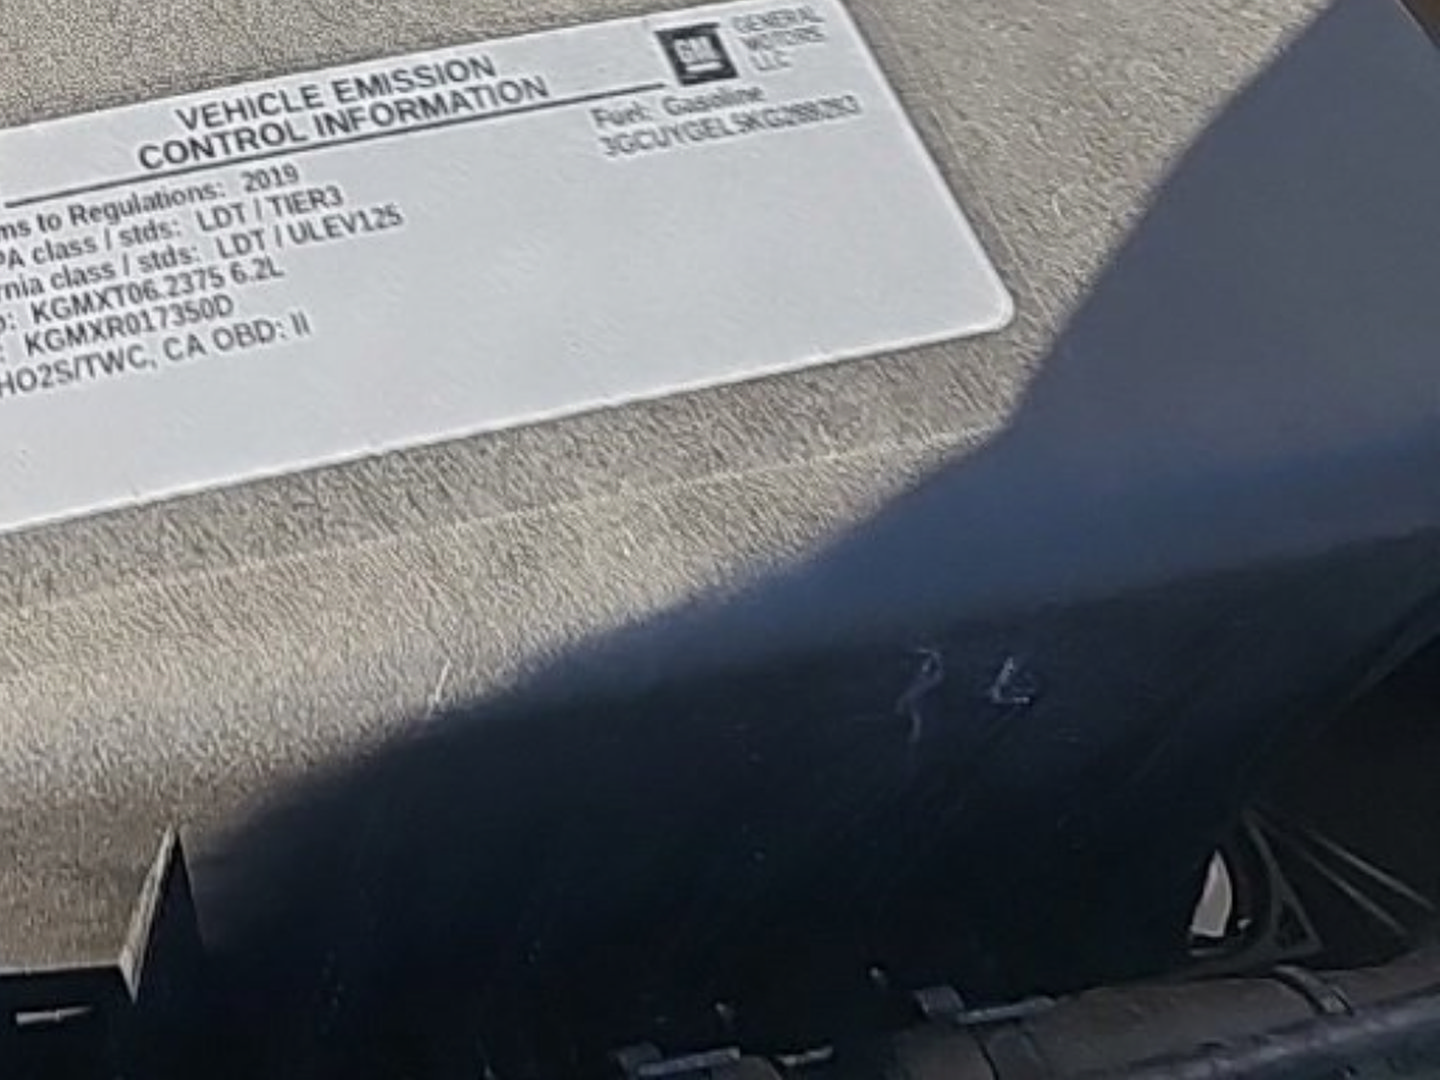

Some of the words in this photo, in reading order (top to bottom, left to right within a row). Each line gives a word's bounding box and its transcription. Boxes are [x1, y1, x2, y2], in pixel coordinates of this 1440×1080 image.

[138, 120, 307, 170] CONTROL
[313, 76, 550, 137] INFORMATION
[176, 83, 324, 131] VEHICLE
[331, 55, 497, 104] EMISSION
[662, 86, 764, 116] Gasoline
[32, 236, 98, 265] class
[118, 219, 182, 248] stds:
[196, 202, 246, 232] LDT
[265, 185, 344, 218] TIER3
[37, 212, 63, 232] to
[68, 182, 226, 226] Regulations:
[241, 163, 300, 193] 2019
[50, 261, 115, 291] class
[137, 245, 200, 272] stds:
[217, 229, 266, 260] LDT
[287, 203, 404, 245] ULEV125
[30, 266, 226, 324] KGMXT06.2375
[230, 256, 285, 285] 6.2L
[163, 334, 207, 361] CA
[213, 319, 287, 351] OBD:
